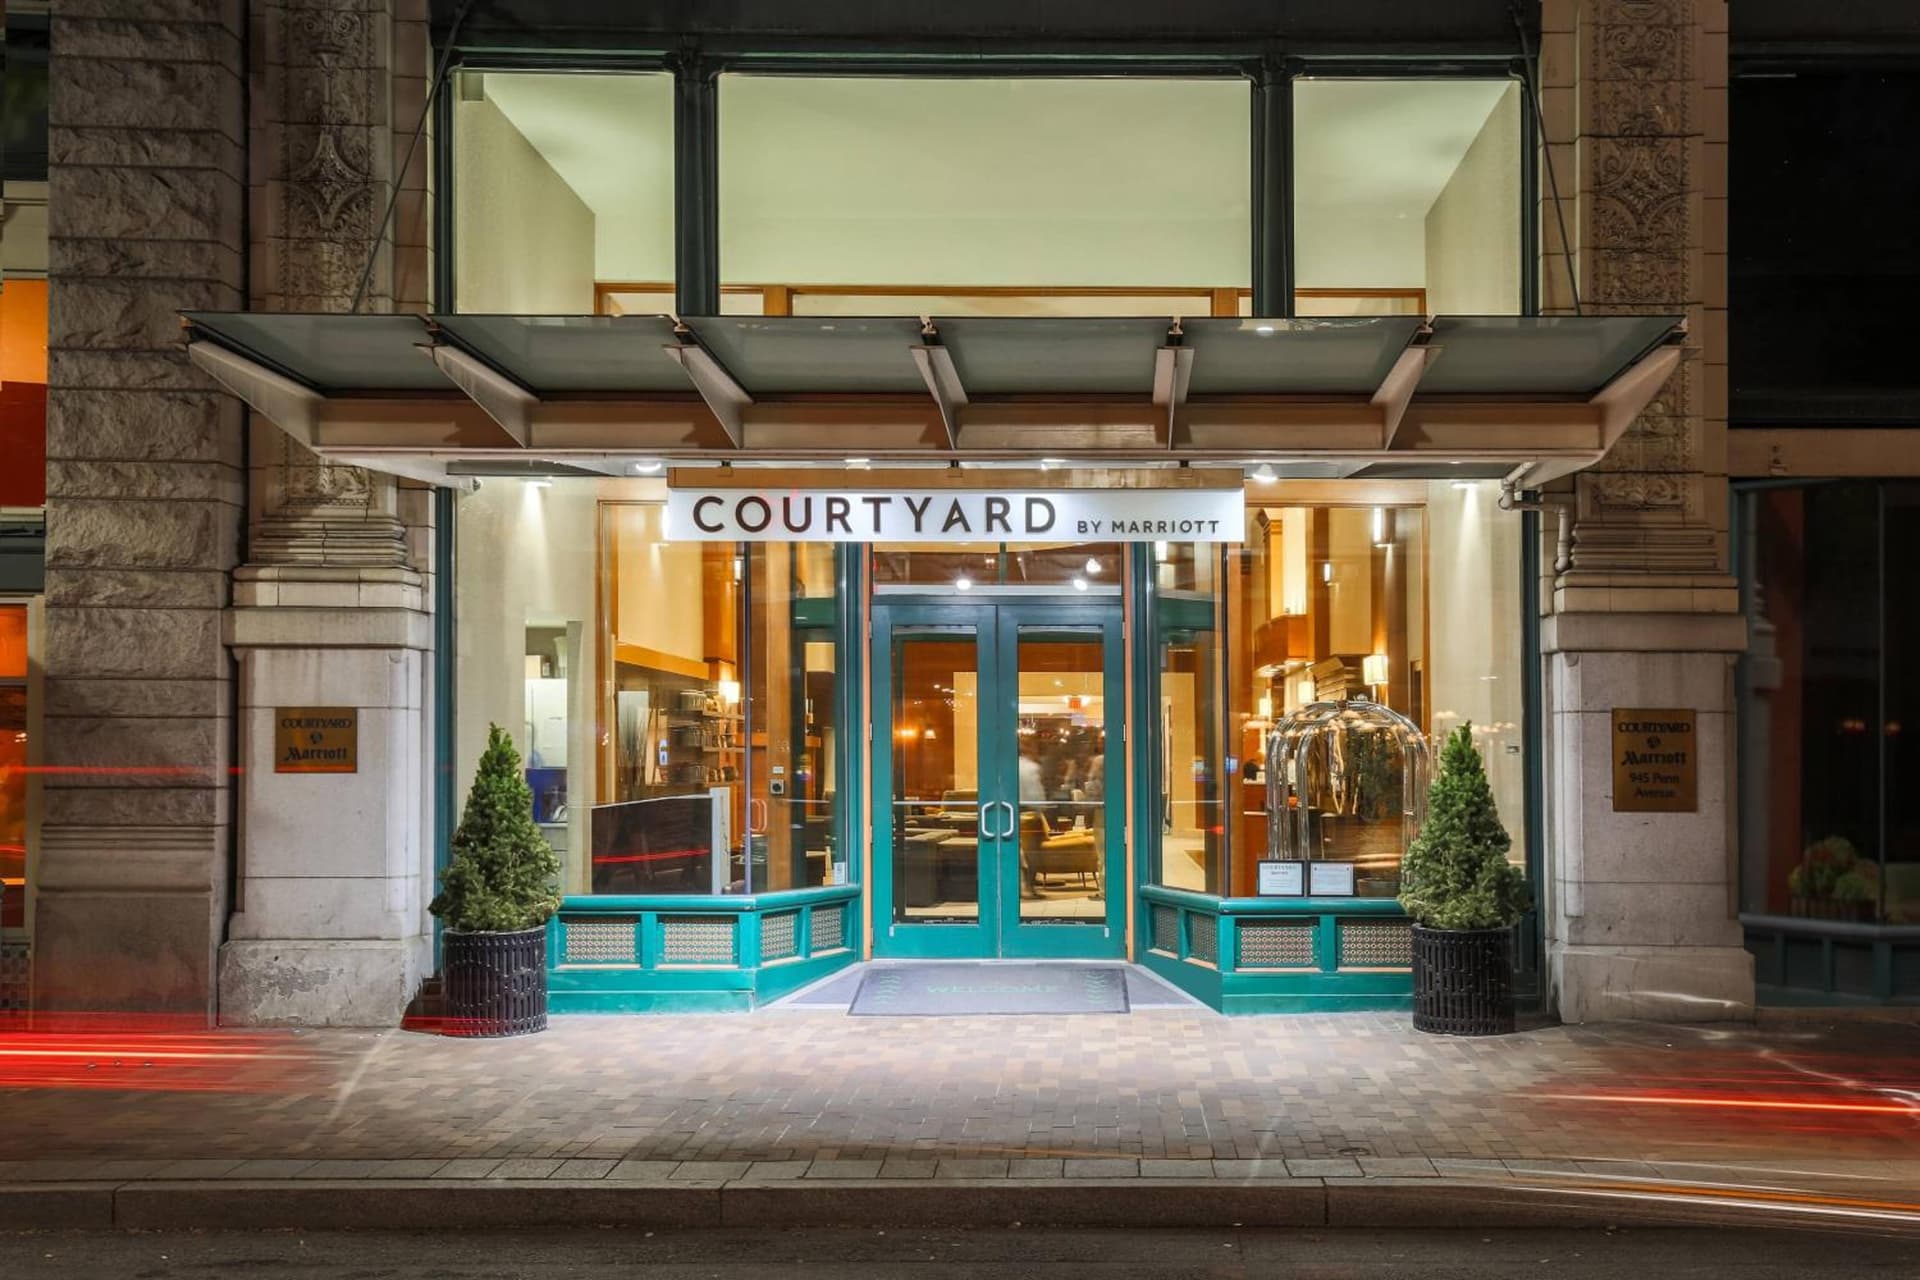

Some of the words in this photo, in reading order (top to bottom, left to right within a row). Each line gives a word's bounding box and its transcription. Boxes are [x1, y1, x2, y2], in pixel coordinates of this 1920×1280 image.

[693, 495, 1057, 533] COURTYARD
[1077, 519, 1100, 533] BY
[1111, 519, 1220, 533] MARRIOTT
[283, 746, 347, 762] Marriott
[1621, 750, 1687, 766] Marriott
